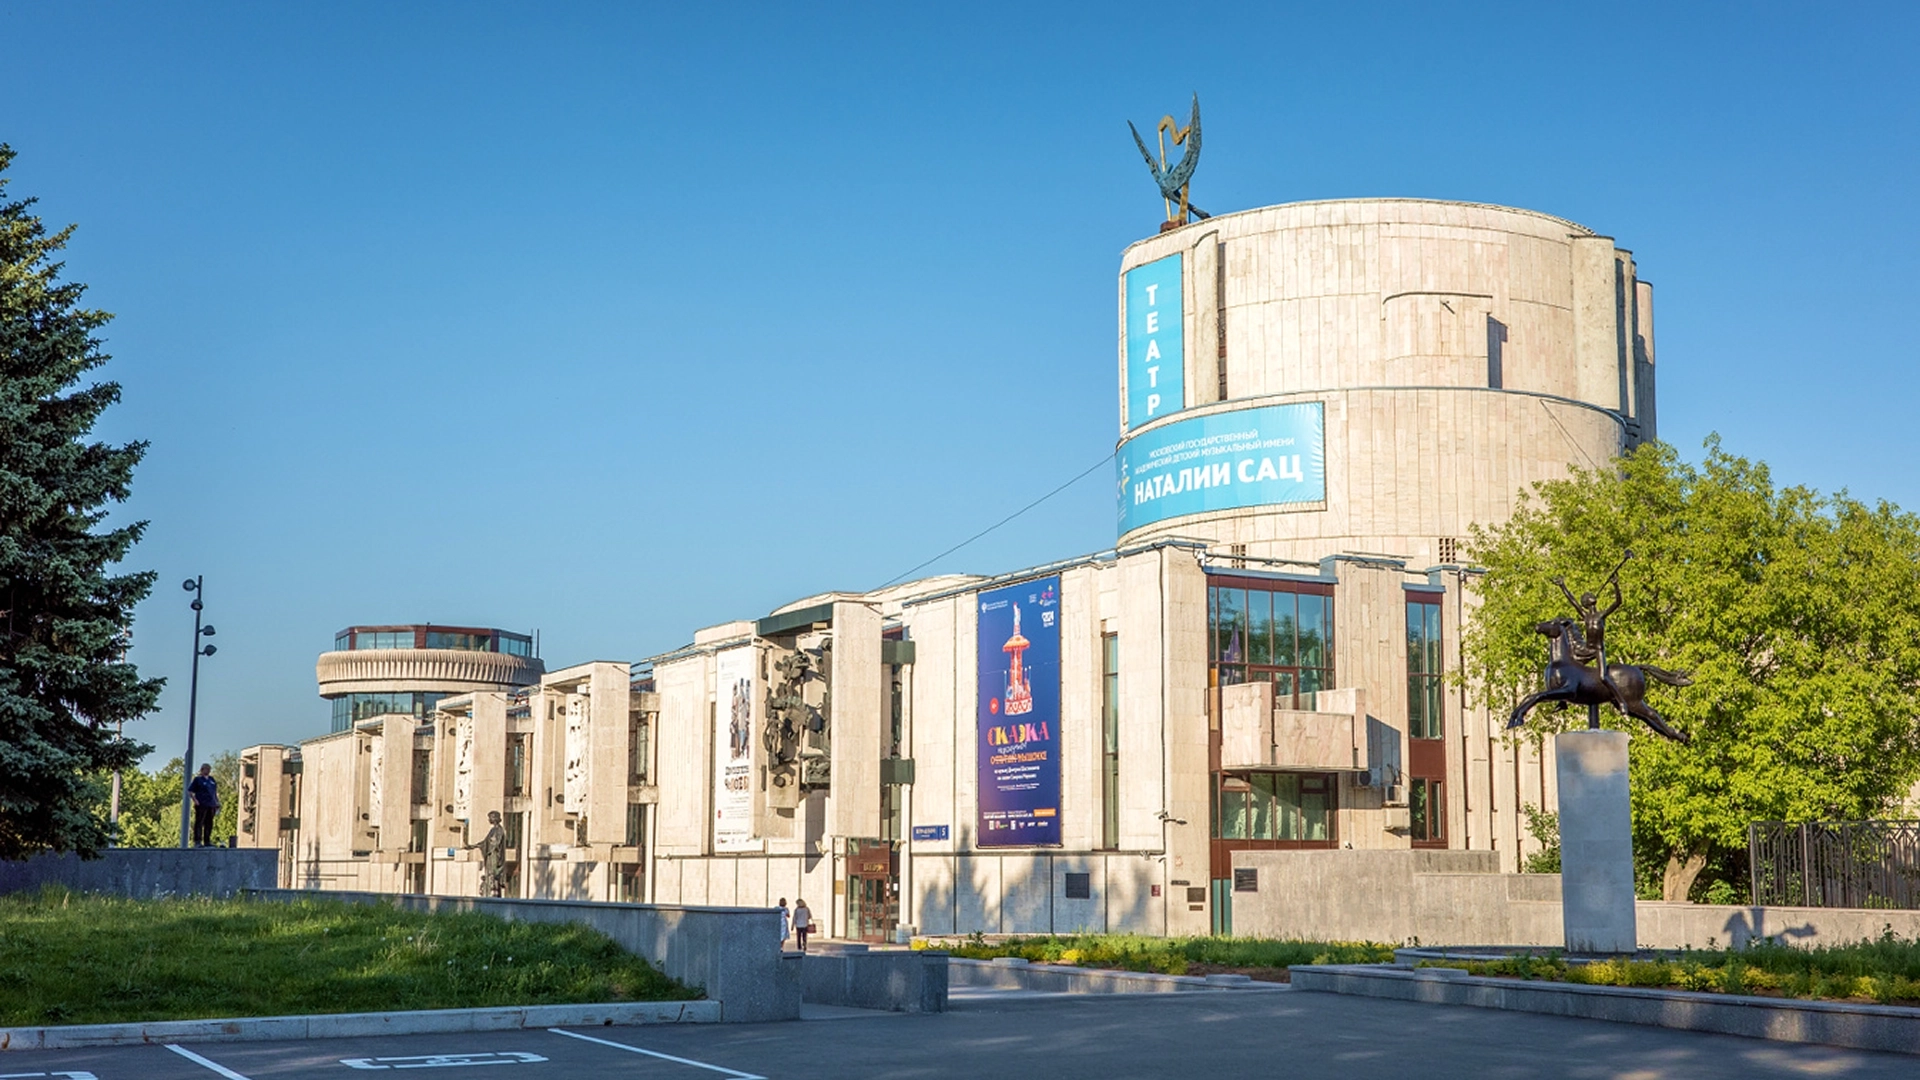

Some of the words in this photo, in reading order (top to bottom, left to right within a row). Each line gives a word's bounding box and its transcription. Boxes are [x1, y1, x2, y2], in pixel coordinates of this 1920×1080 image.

[1145, 284, 1161, 416] ТЕАТР
[1186, 429, 1258, 447] ГОСУДАРСТВЕННЫЙ
[1201, 439, 1262, 456] МУЗЫКАЛЬНЫЙ
[1262, 437, 1295, 449] ИМЕНИ
[1134, 462, 1231, 506] НАТАЛИИ
[1237, 454, 1304, 484] САЦ
[987, 721, 1050, 746] СКАЗКА
